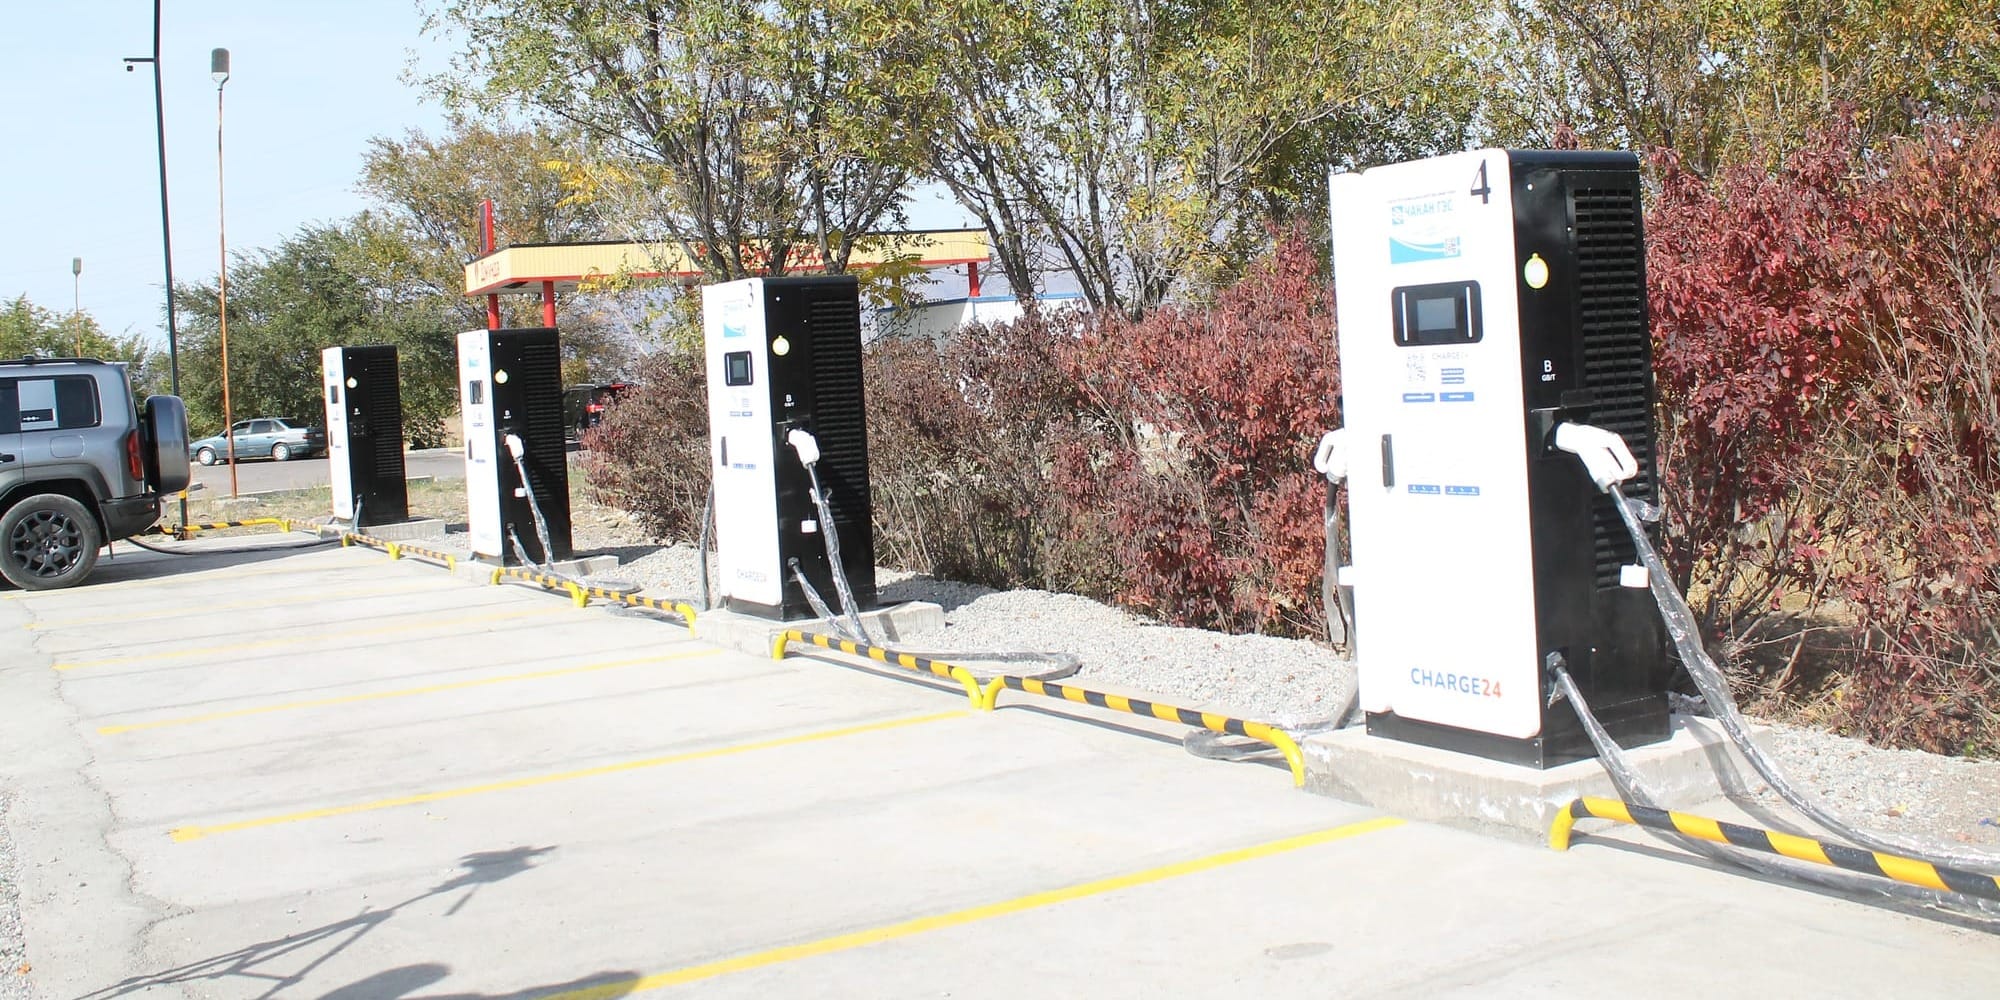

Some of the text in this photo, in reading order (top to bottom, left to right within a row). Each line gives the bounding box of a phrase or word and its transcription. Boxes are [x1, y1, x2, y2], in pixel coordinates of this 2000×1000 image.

[1470, 159, 1491, 205] 4
[748, 282, 754, 308] 3
[1543, 359, 1553, 373] B
[1410, 667, 1503, 699] CHARGE24
